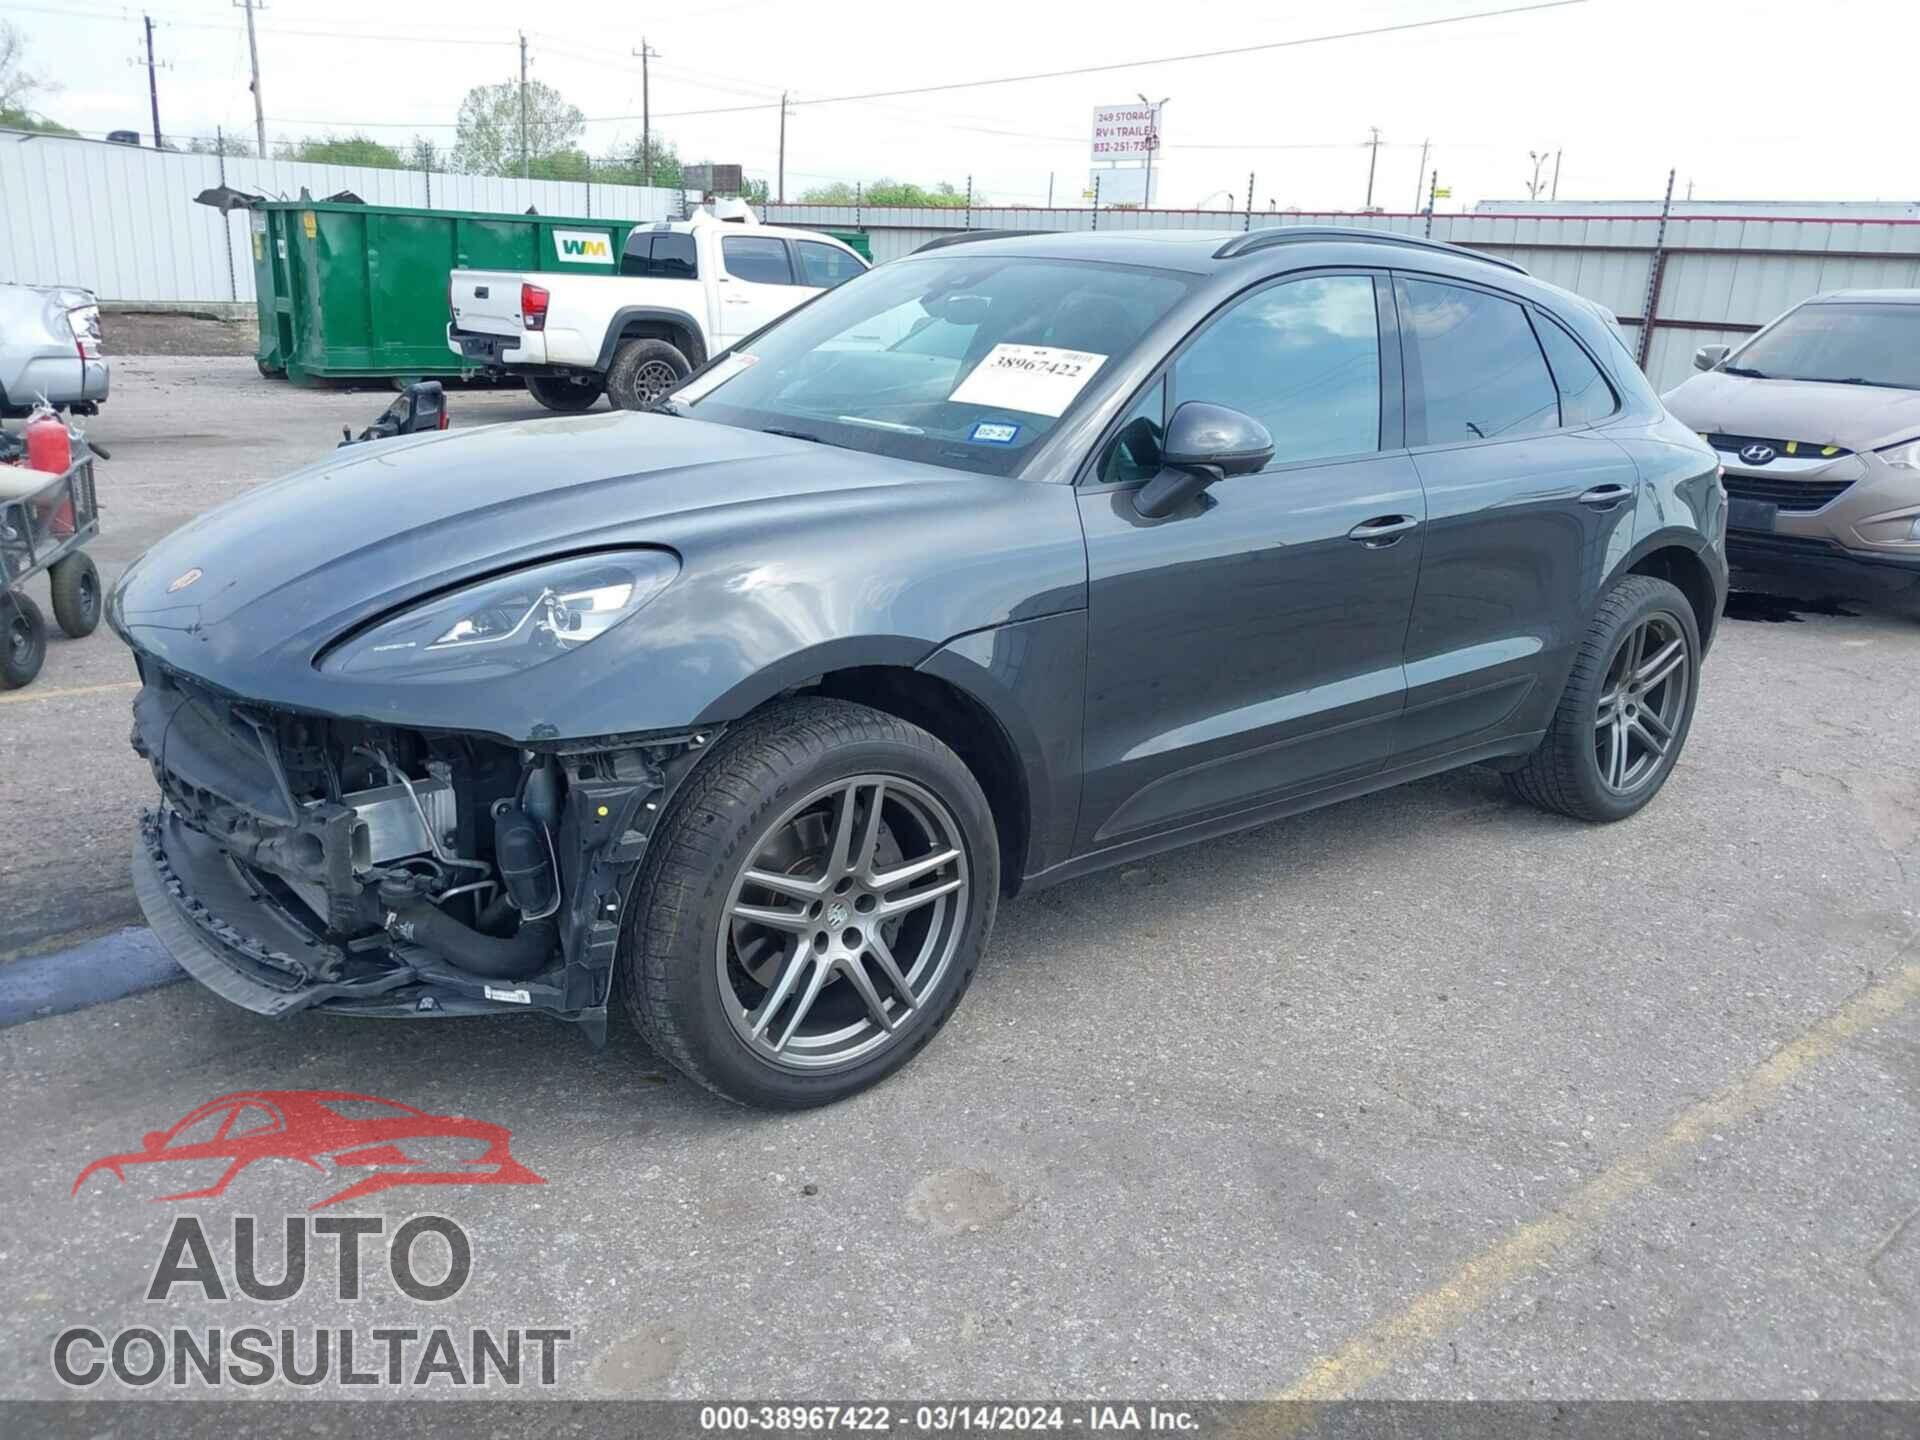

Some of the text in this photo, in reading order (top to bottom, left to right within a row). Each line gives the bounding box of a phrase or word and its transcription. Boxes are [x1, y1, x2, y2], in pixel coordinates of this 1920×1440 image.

[1115, 111, 1154, 122] STORAG
[1096, 127, 1109, 137] RV
[1117, 126, 1157, 137] TRAILER
[563, 240, 607, 256] WM
[990, 356, 1083, 377] 38967422
